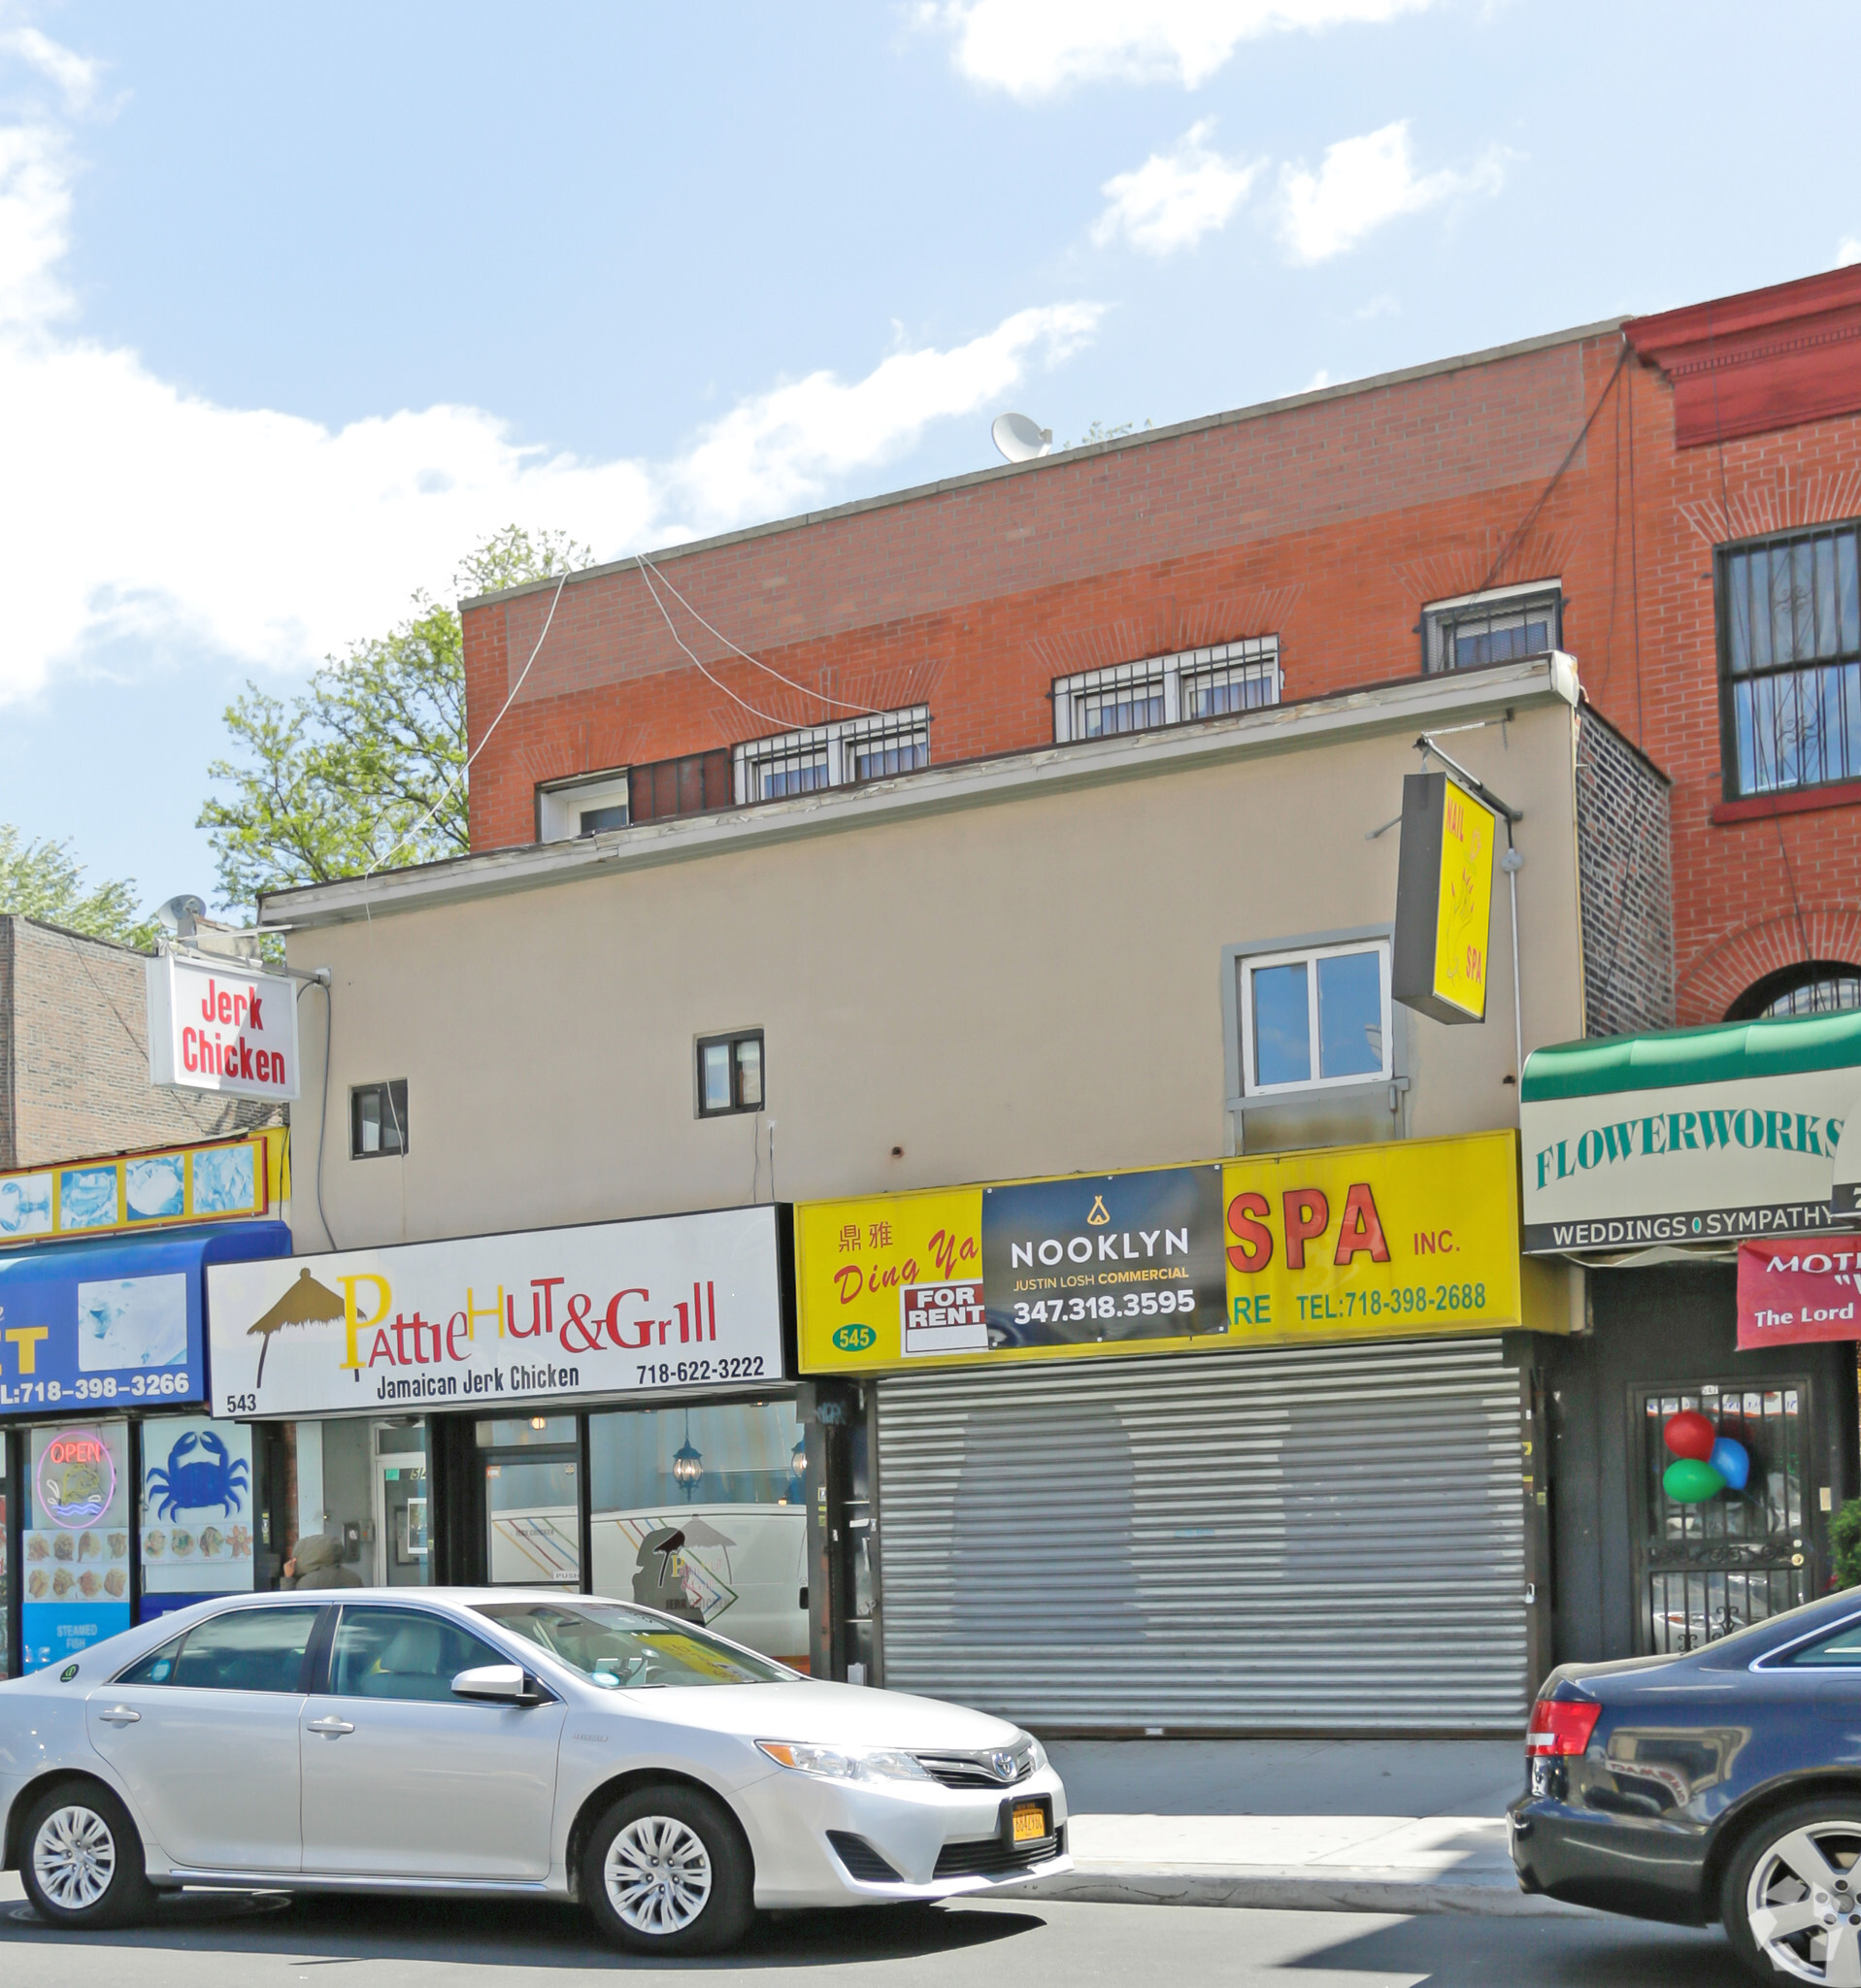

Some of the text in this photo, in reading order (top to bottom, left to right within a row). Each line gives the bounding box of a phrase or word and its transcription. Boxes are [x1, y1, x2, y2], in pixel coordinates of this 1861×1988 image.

[1446, 796, 1464, 843] NAIL
[1466, 944, 1482, 985] SPA
[201, 978, 264, 1031] Jerk
[183, 1026, 285, 1085] Chicken
[1536, 1109, 1844, 1191] FLOWERWORKS
[839, 1220, 894, 1253] 鼎雅
[1226, 1183, 1391, 1274] SPA
[1413, 1229, 1461, 1255] INC.
[1553, 1205, 1833, 1245] WEDDINGS SYMPATHY
[833, 1229, 980, 1306] Ding Ya
[1011, 1227, 1189, 1269] NOOKLYN
[1766, 1252, 1861, 1275] MOT
[916, 1286, 976, 1309] FOR
[1013, 1266, 1190, 1292] JUSTIN LOSH COMMERCIAL
[908, 1305, 985, 1329] RENT
[1013, 1288, 1196, 1325] 347.318.3595
[1227, 1282, 1486, 1325] RE TEL:718-398-2688
[1753, 1302, 1854, 1328] The Lord
[0, 1326, 49, 1375] T
[839, 1327, 871, 1349] 545
[377, 1355, 765, 1400] Jamaican Jerk Chicken 718-622-3222
[226, 1394, 257, 1413] 543
[50, 1441, 102, 1464] OPEN
